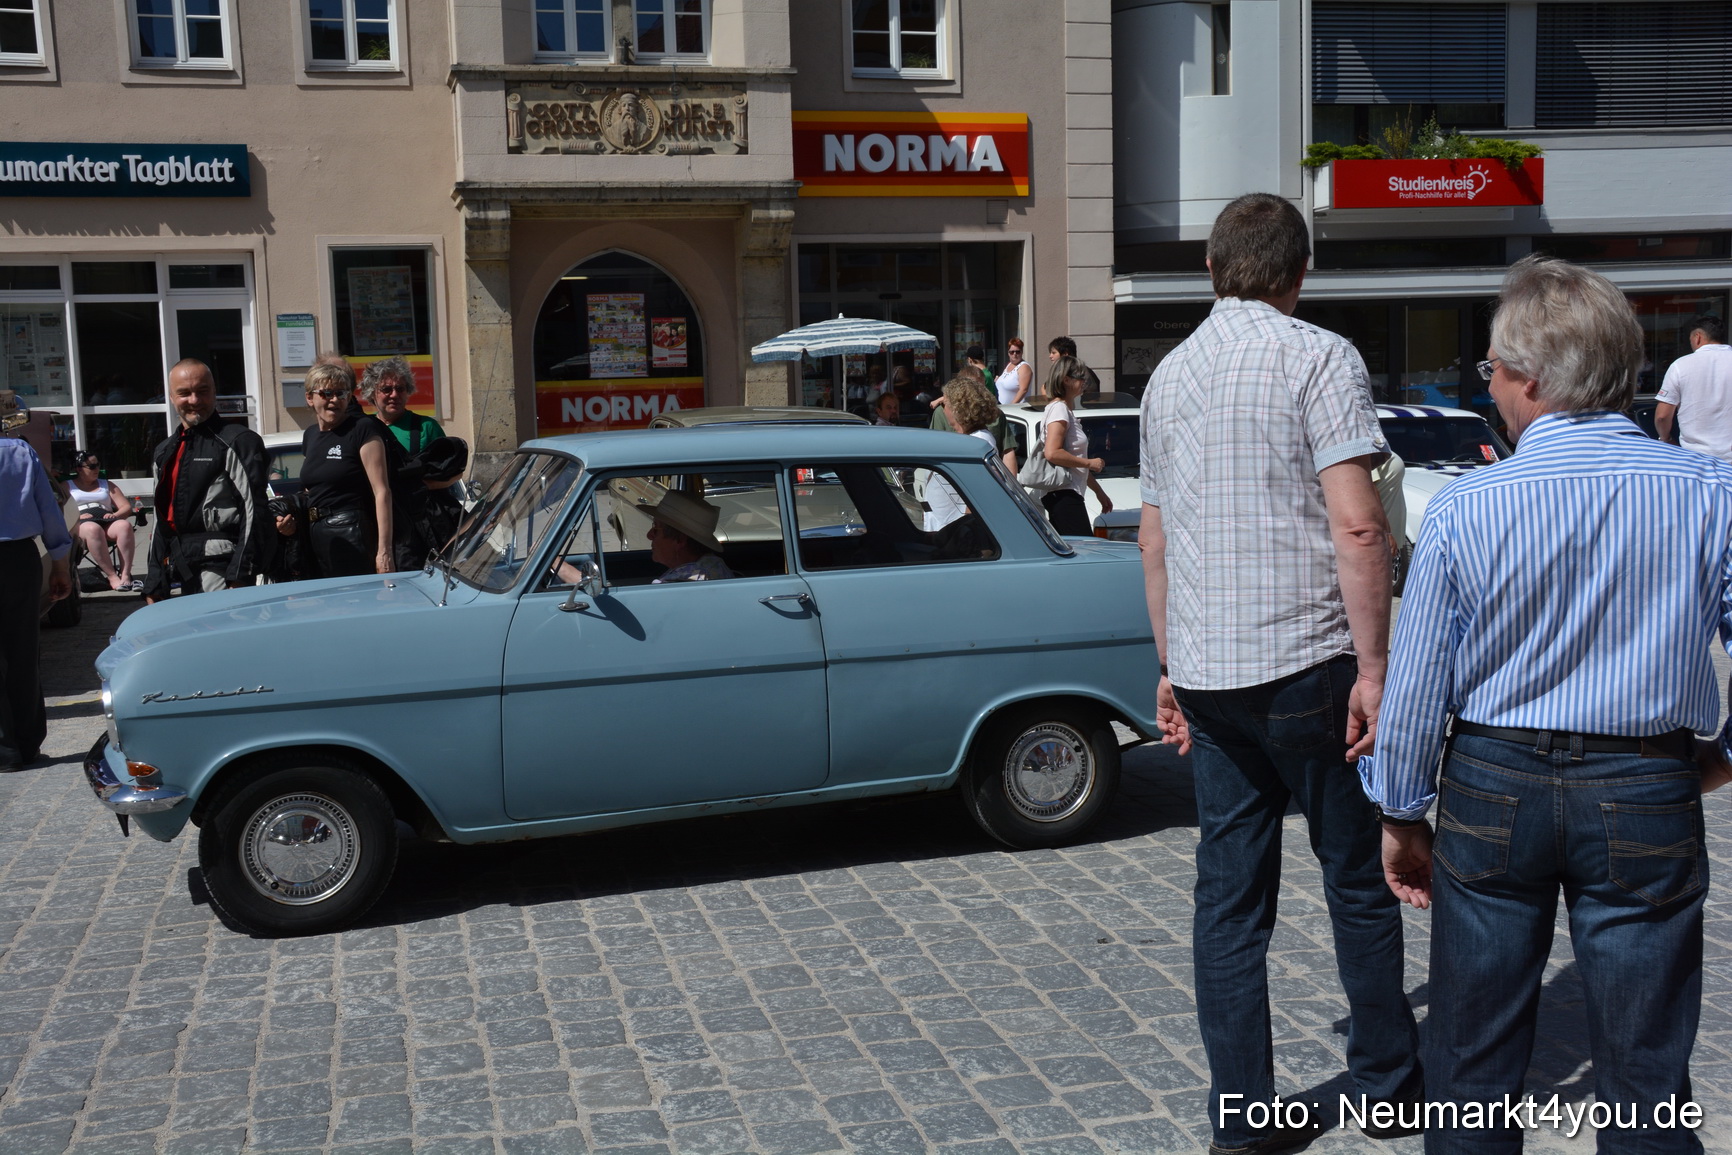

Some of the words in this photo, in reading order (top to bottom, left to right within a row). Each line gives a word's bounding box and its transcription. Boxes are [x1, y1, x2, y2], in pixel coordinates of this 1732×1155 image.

[669, 103, 703, 119] DIE
[664, 120, 734, 136] KUNST
[823, 133, 1004, 173] NORMA
[122, 154, 235, 186] Tagblatt
[1388, 175, 1474, 191] Studienkreis
[1399, 191, 1443, 199] Profi-Nachhilfe
[1153, 321, 1190, 330] Obere
[561, 394, 681, 423] NORMA
